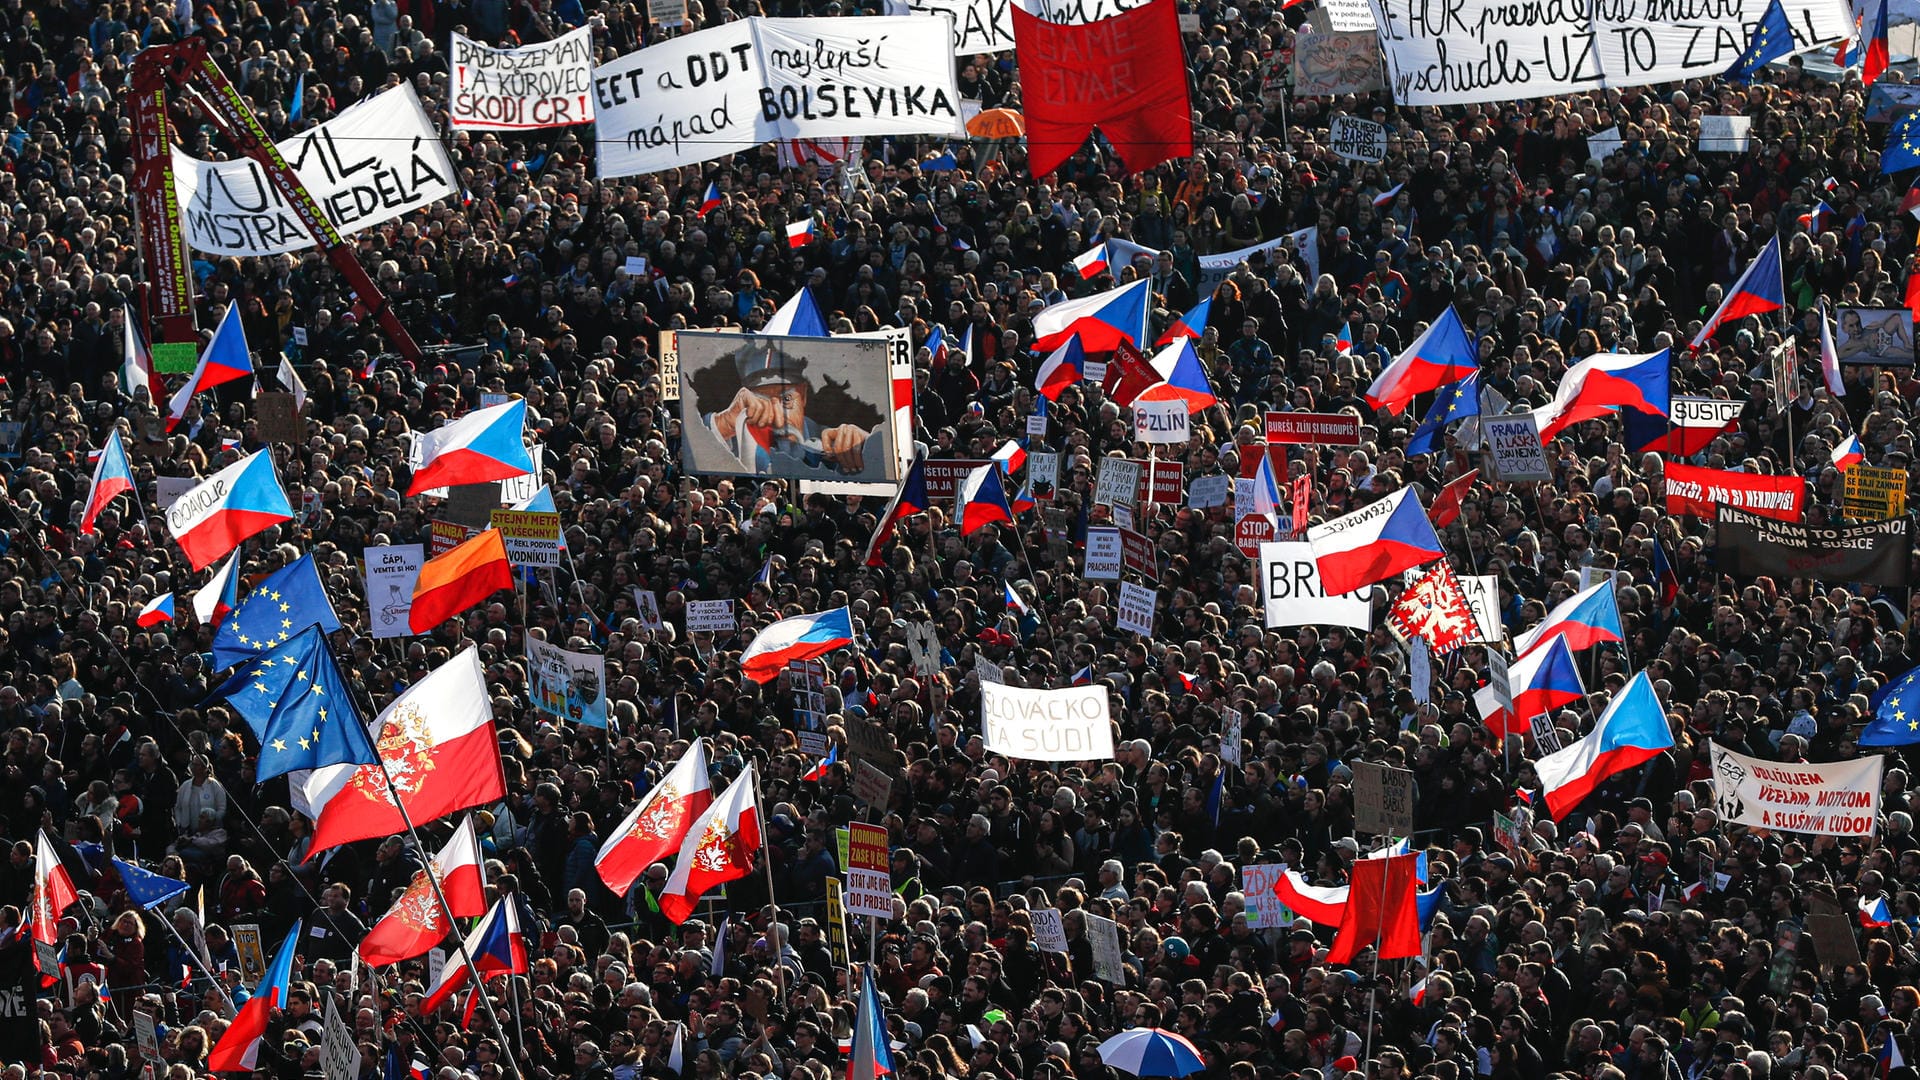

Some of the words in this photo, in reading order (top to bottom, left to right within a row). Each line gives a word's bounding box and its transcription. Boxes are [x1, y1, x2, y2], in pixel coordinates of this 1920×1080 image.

[1612, 27, 1656, 76] TO
[596, 68, 644, 110] EET
[770, 35, 889, 79] nejlepší
[472, 70, 488, 93] A
[533, 93, 573, 124] ČR
[627, 92, 734, 156] nápad
[758, 78, 957, 122] BOLŠEVIKA
[1149, 409, 1185, 431] ZLÍN
[1268, 419, 1295, 433] BUREŠI,
[1296, 420, 1312, 433] ZLÍN
[1312, 422, 1320, 434] SI
[1491, 422, 1530, 436] PRAVDA
[1497, 459, 1544, 473] SPOKO
[1707, 485, 1730, 504] NÁS
[1731, 489, 1744, 506] SI
[493, 512, 529, 524] STEJNÝ
[531, 513, 558, 526] METR
[1719, 508, 1764, 528] NENÍ
[1768, 521, 1808, 538] NÁM
[1811, 529, 1838, 539] TO
[1842, 520, 1906, 538] JEDNO!
[432, 522, 464, 539] HANBA
[512, 525, 547, 538] VŠECHNY
[1242, 521, 1269, 535] STOP
[1758, 532, 1808, 548] FÓRUM
[383, 553, 406, 566] ČÁPI,
[373, 566, 396, 574] VEMTE
[984, 690, 1102, 721] SLOVÁCKO
[1022, 723, 1095, 752] SÚDÍ
[1751, 765, 1824, 786] UBLIŽUJEM
[1763, 810, 1771, 826] A
[851, 847, 869, 863] ZASE
[850, 871, 865, 888] STÁT
[850, 893, 861, 907] DO
